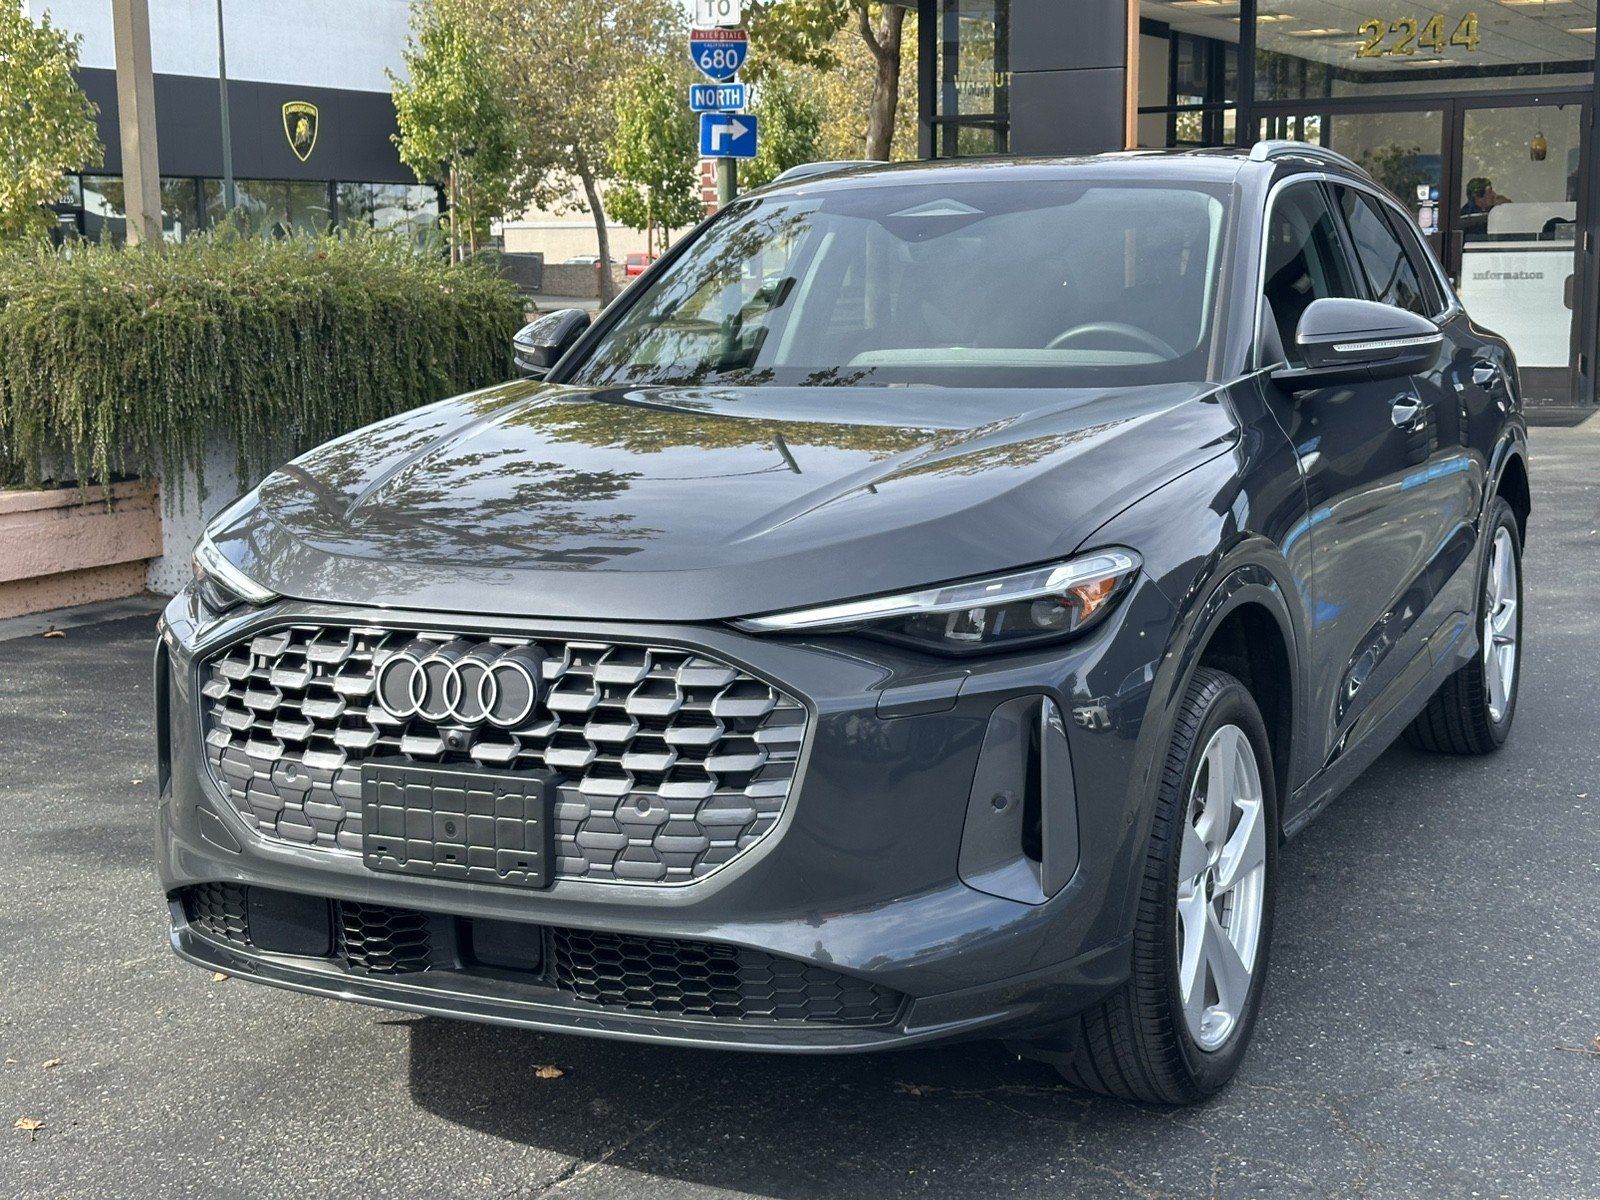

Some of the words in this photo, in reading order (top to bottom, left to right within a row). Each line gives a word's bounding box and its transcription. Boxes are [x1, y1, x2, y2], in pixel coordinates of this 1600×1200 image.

[705, 0, 731, 17] TO
[695, 31, 742, 39] INTERSTATE
[1357, 11, 1481, 58] 2244
[700, 49, 738, 69] 680
[695, 88, 740, 106] NORTH
[1473, 270, 1544, 280] information
